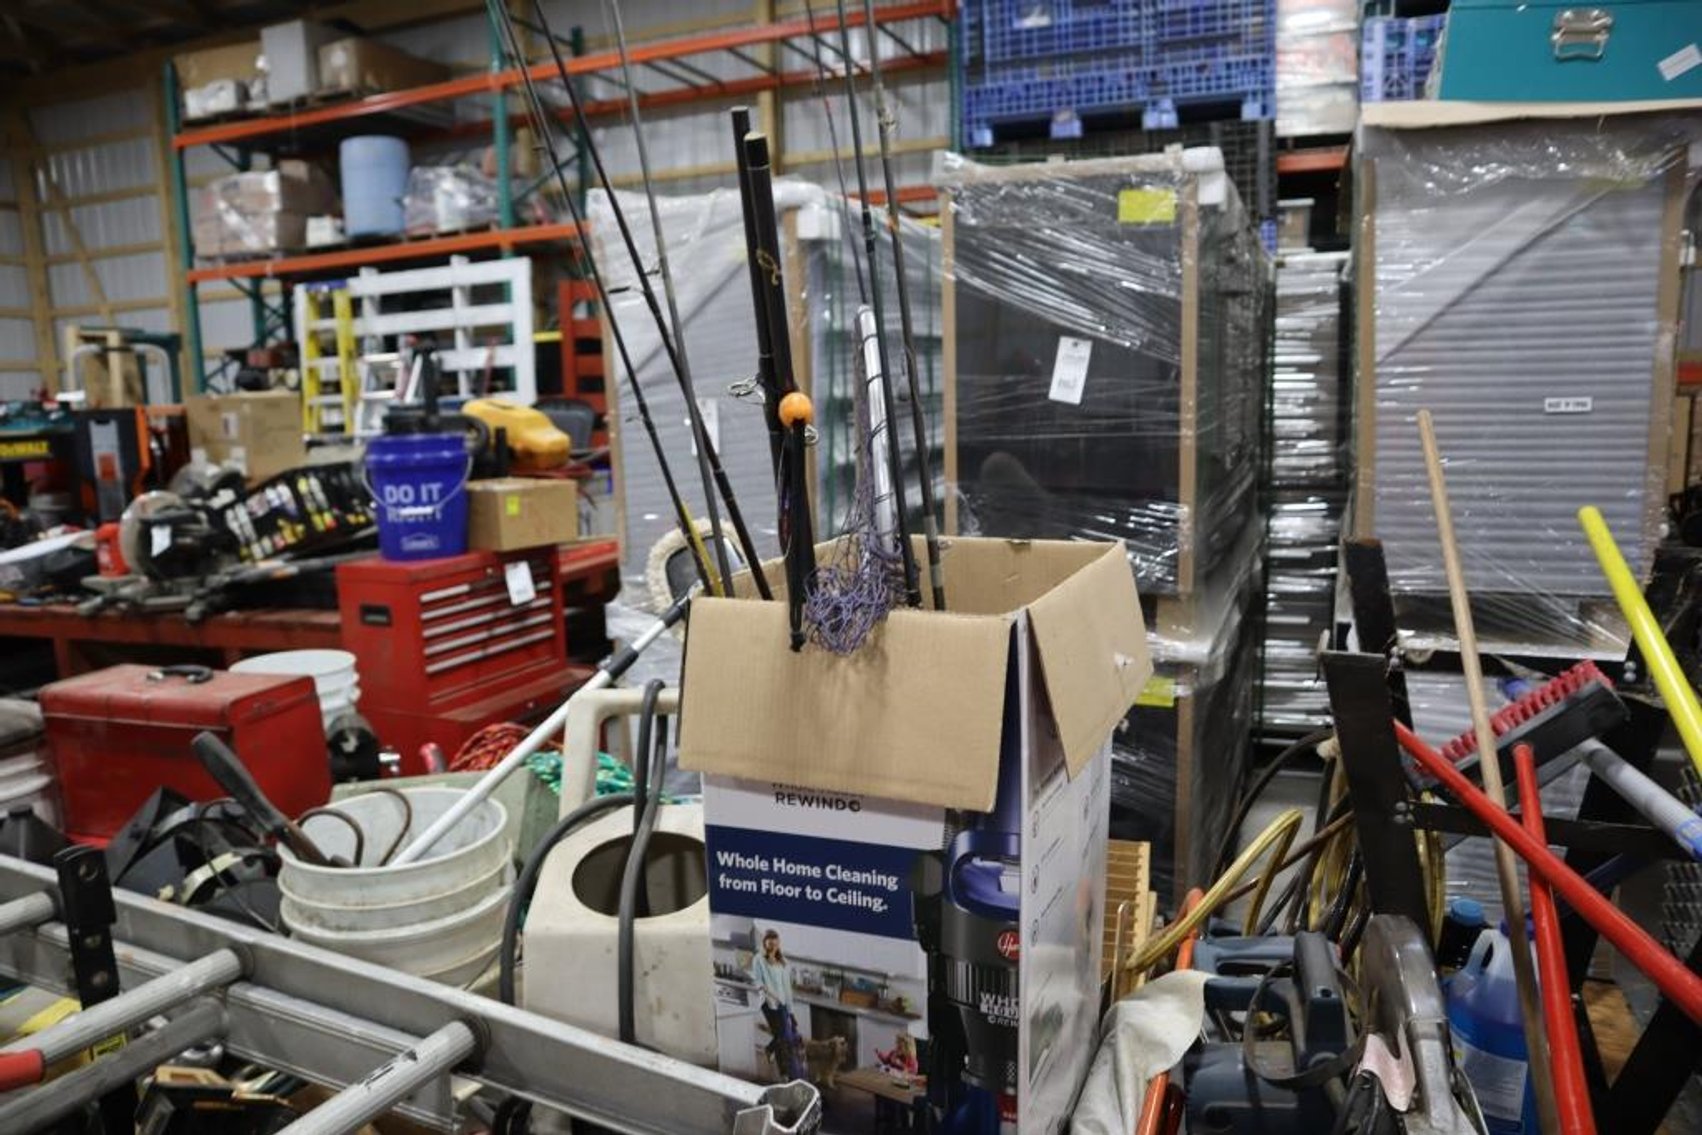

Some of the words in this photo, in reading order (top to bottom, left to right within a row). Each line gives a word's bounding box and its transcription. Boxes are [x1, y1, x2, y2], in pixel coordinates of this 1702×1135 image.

[384, 484, 415, 504] DO
[421, 482, 443, 502] IT
[716, 850, 769, 872] Whole
[773, 857, 822, 878] Home
[825, 864, 899, 891] Cleaning
[719, 872, 758, 892] from
[761, 878, 802, 898] Floor
[805, 885, 823, 901] to
[826, 887, 888, 912] Ceiling.
